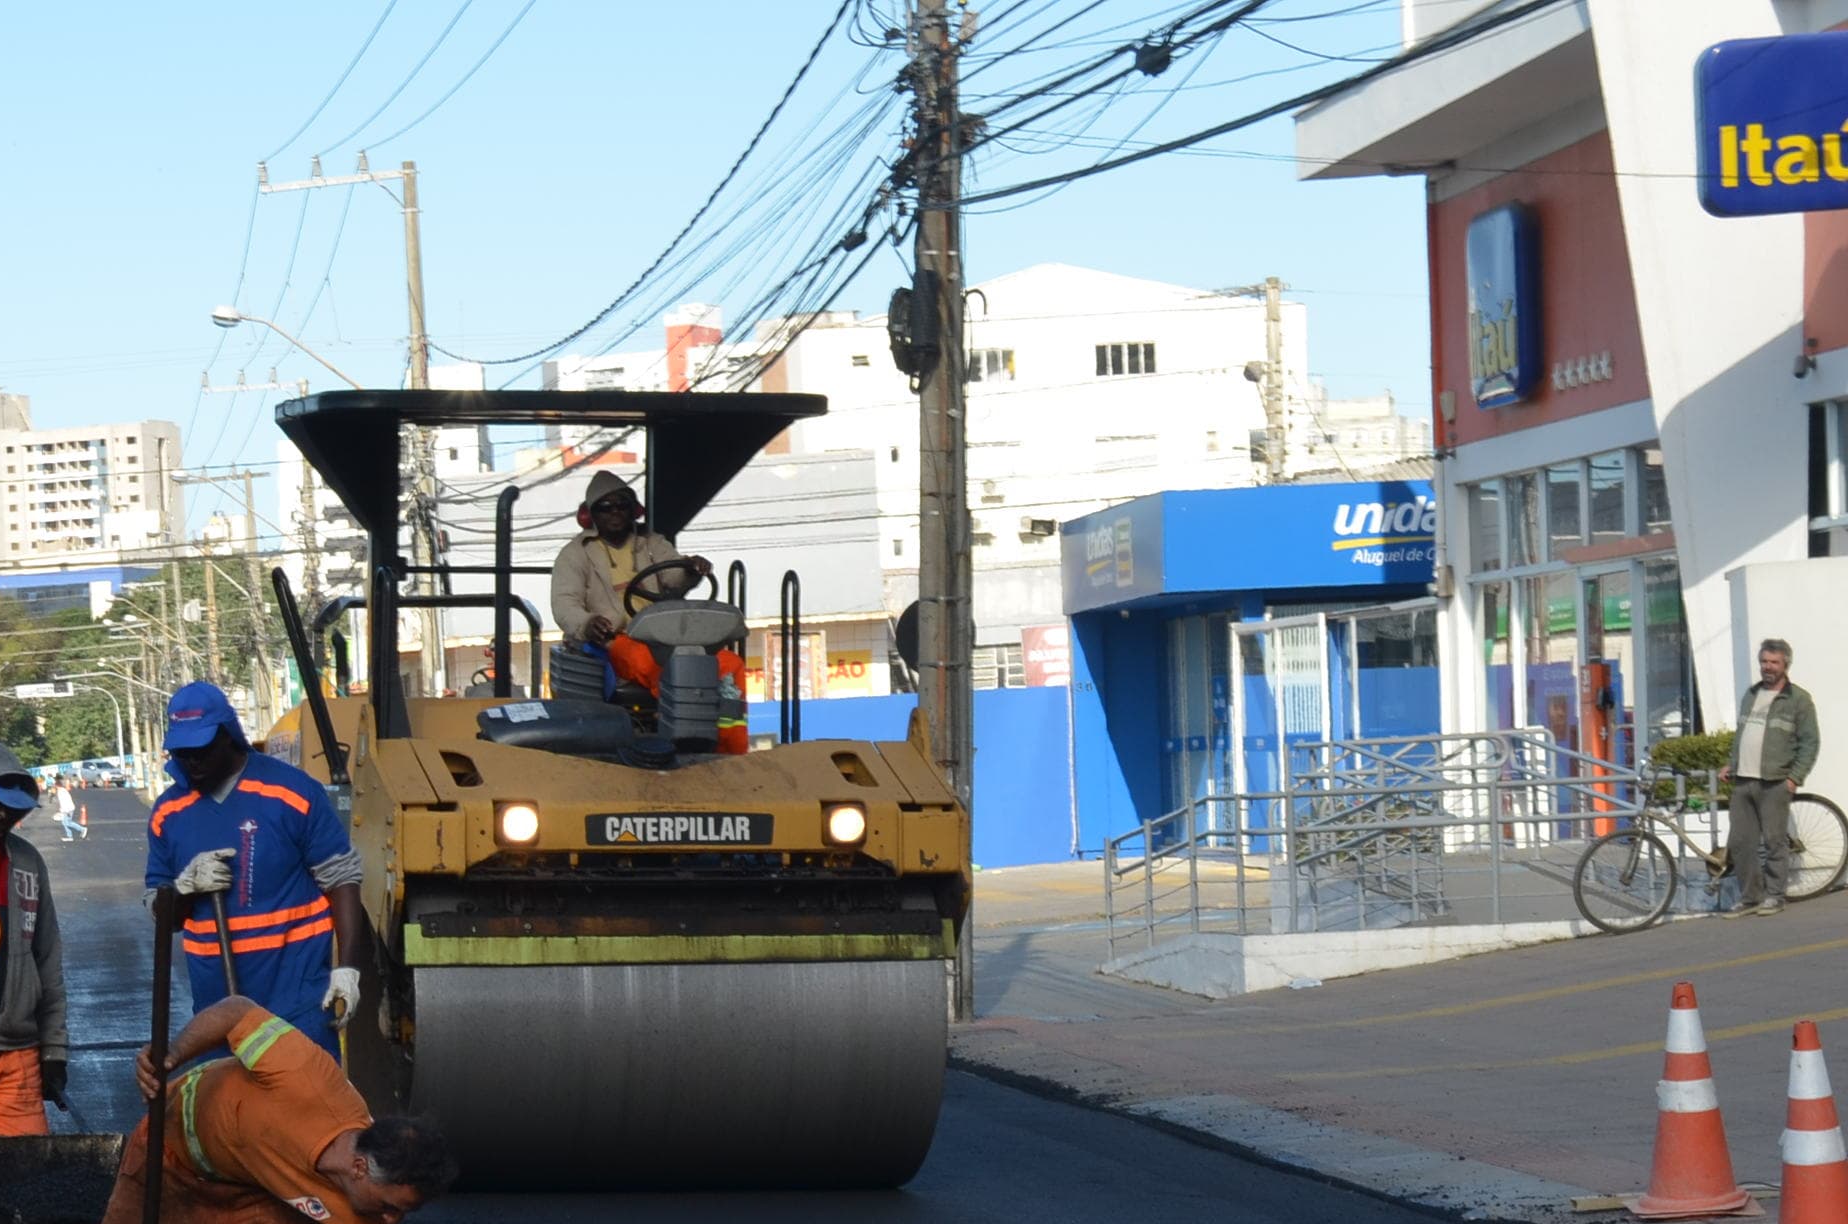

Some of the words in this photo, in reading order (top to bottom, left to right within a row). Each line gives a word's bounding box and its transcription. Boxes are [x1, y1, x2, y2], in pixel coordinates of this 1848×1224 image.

[1470, 299, 1517, 378] Itaú
[1333, 495, 1436, 535] unida
[1352, 549, 1405, 566] Aluguel
[1406, 548, 1424, 562] de
[605, 815, 751, 842] CATERPILLAR
